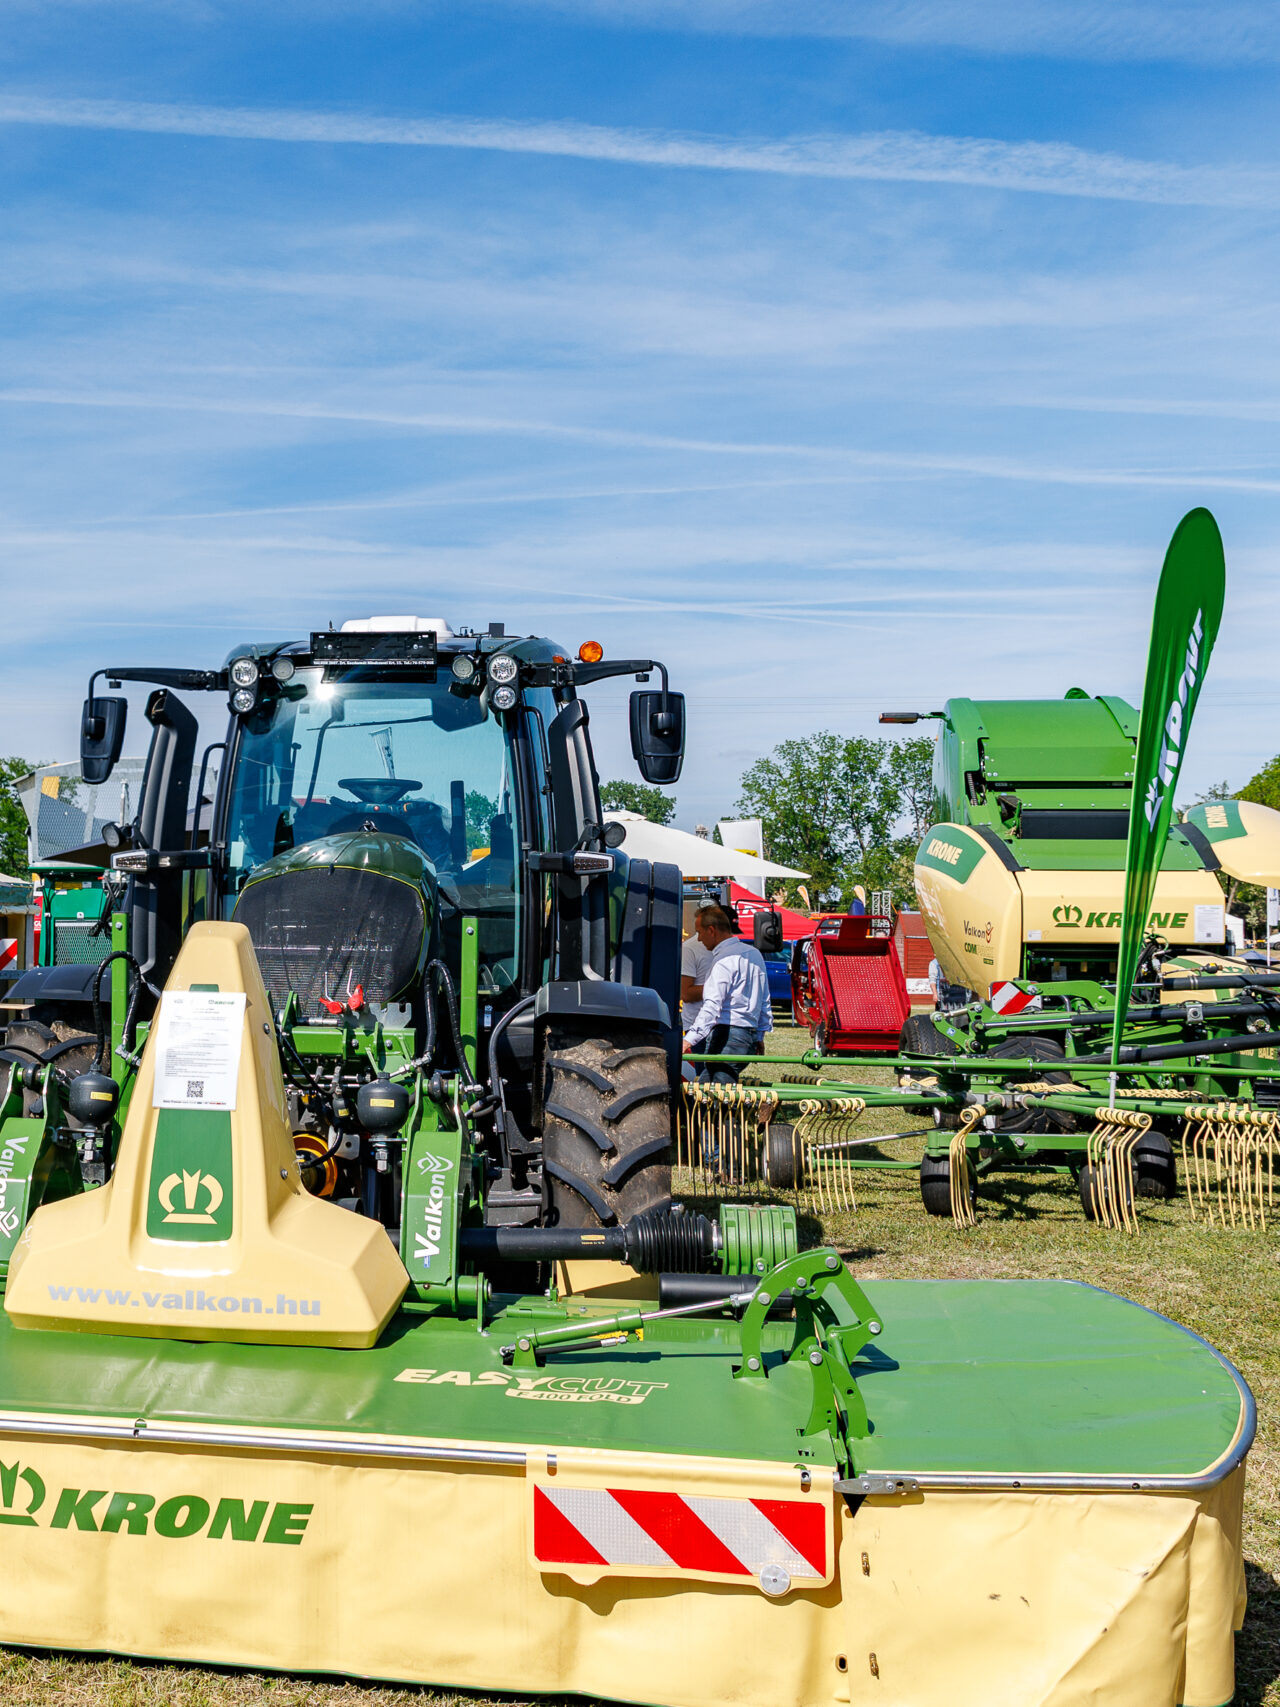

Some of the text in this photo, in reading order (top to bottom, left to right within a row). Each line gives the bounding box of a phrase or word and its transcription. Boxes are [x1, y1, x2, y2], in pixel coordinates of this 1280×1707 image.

[926, 838, 963, 866] KRONE
[963, 920, 986, 939] Valkon
[1085, 912, 1189, 929] KRNE
[413, 1173, 446, 1259] Valkon
[47, 1284, 321, 1316] www.valkon.hu
[392, 1368, 670, 1397] EASYCUT
[529, 1391, 572, 1401] 400
[576, 1392, 633, 1403] FOLD
[49, 1486, 314, 1546] KRONE
